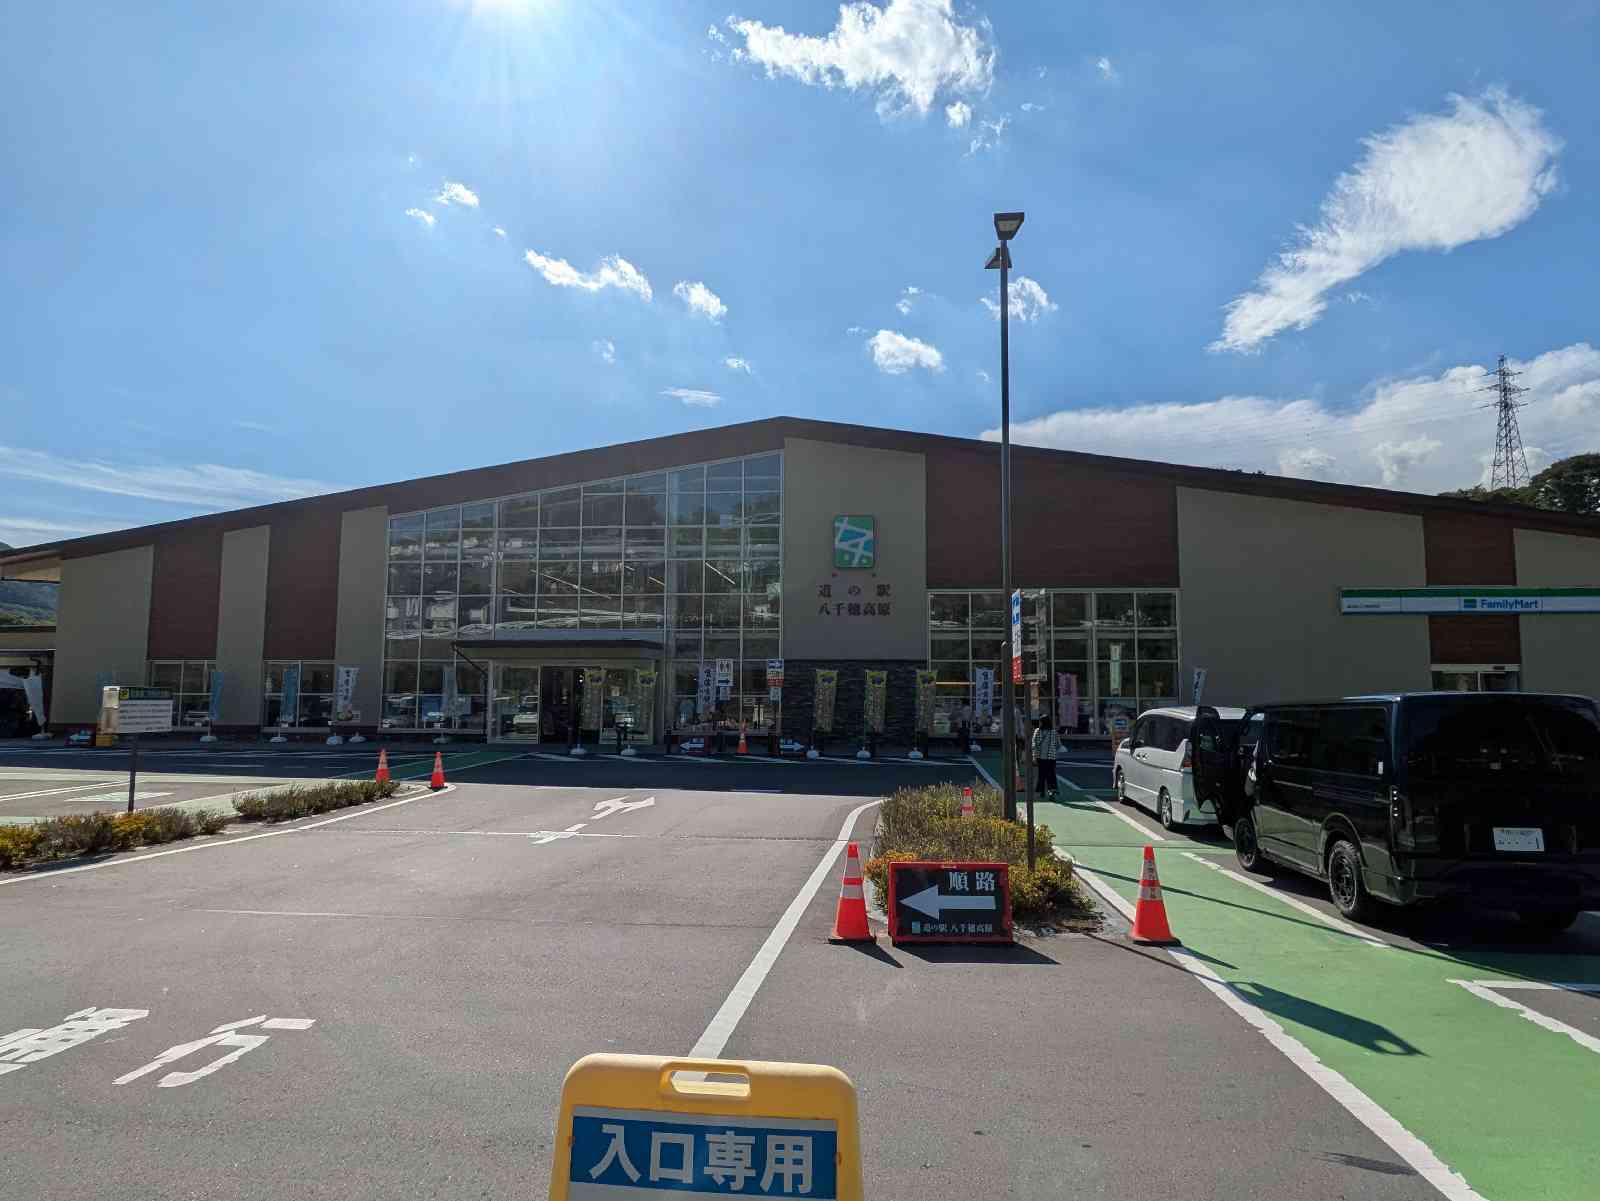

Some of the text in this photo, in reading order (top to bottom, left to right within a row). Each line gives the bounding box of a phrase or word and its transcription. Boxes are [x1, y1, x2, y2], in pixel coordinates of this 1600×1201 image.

[1480, 599, 1538, 611] FamilyMart
[949, 872, 995, 891] 順路
[589, 1124, 813, 1194] 入口専用
